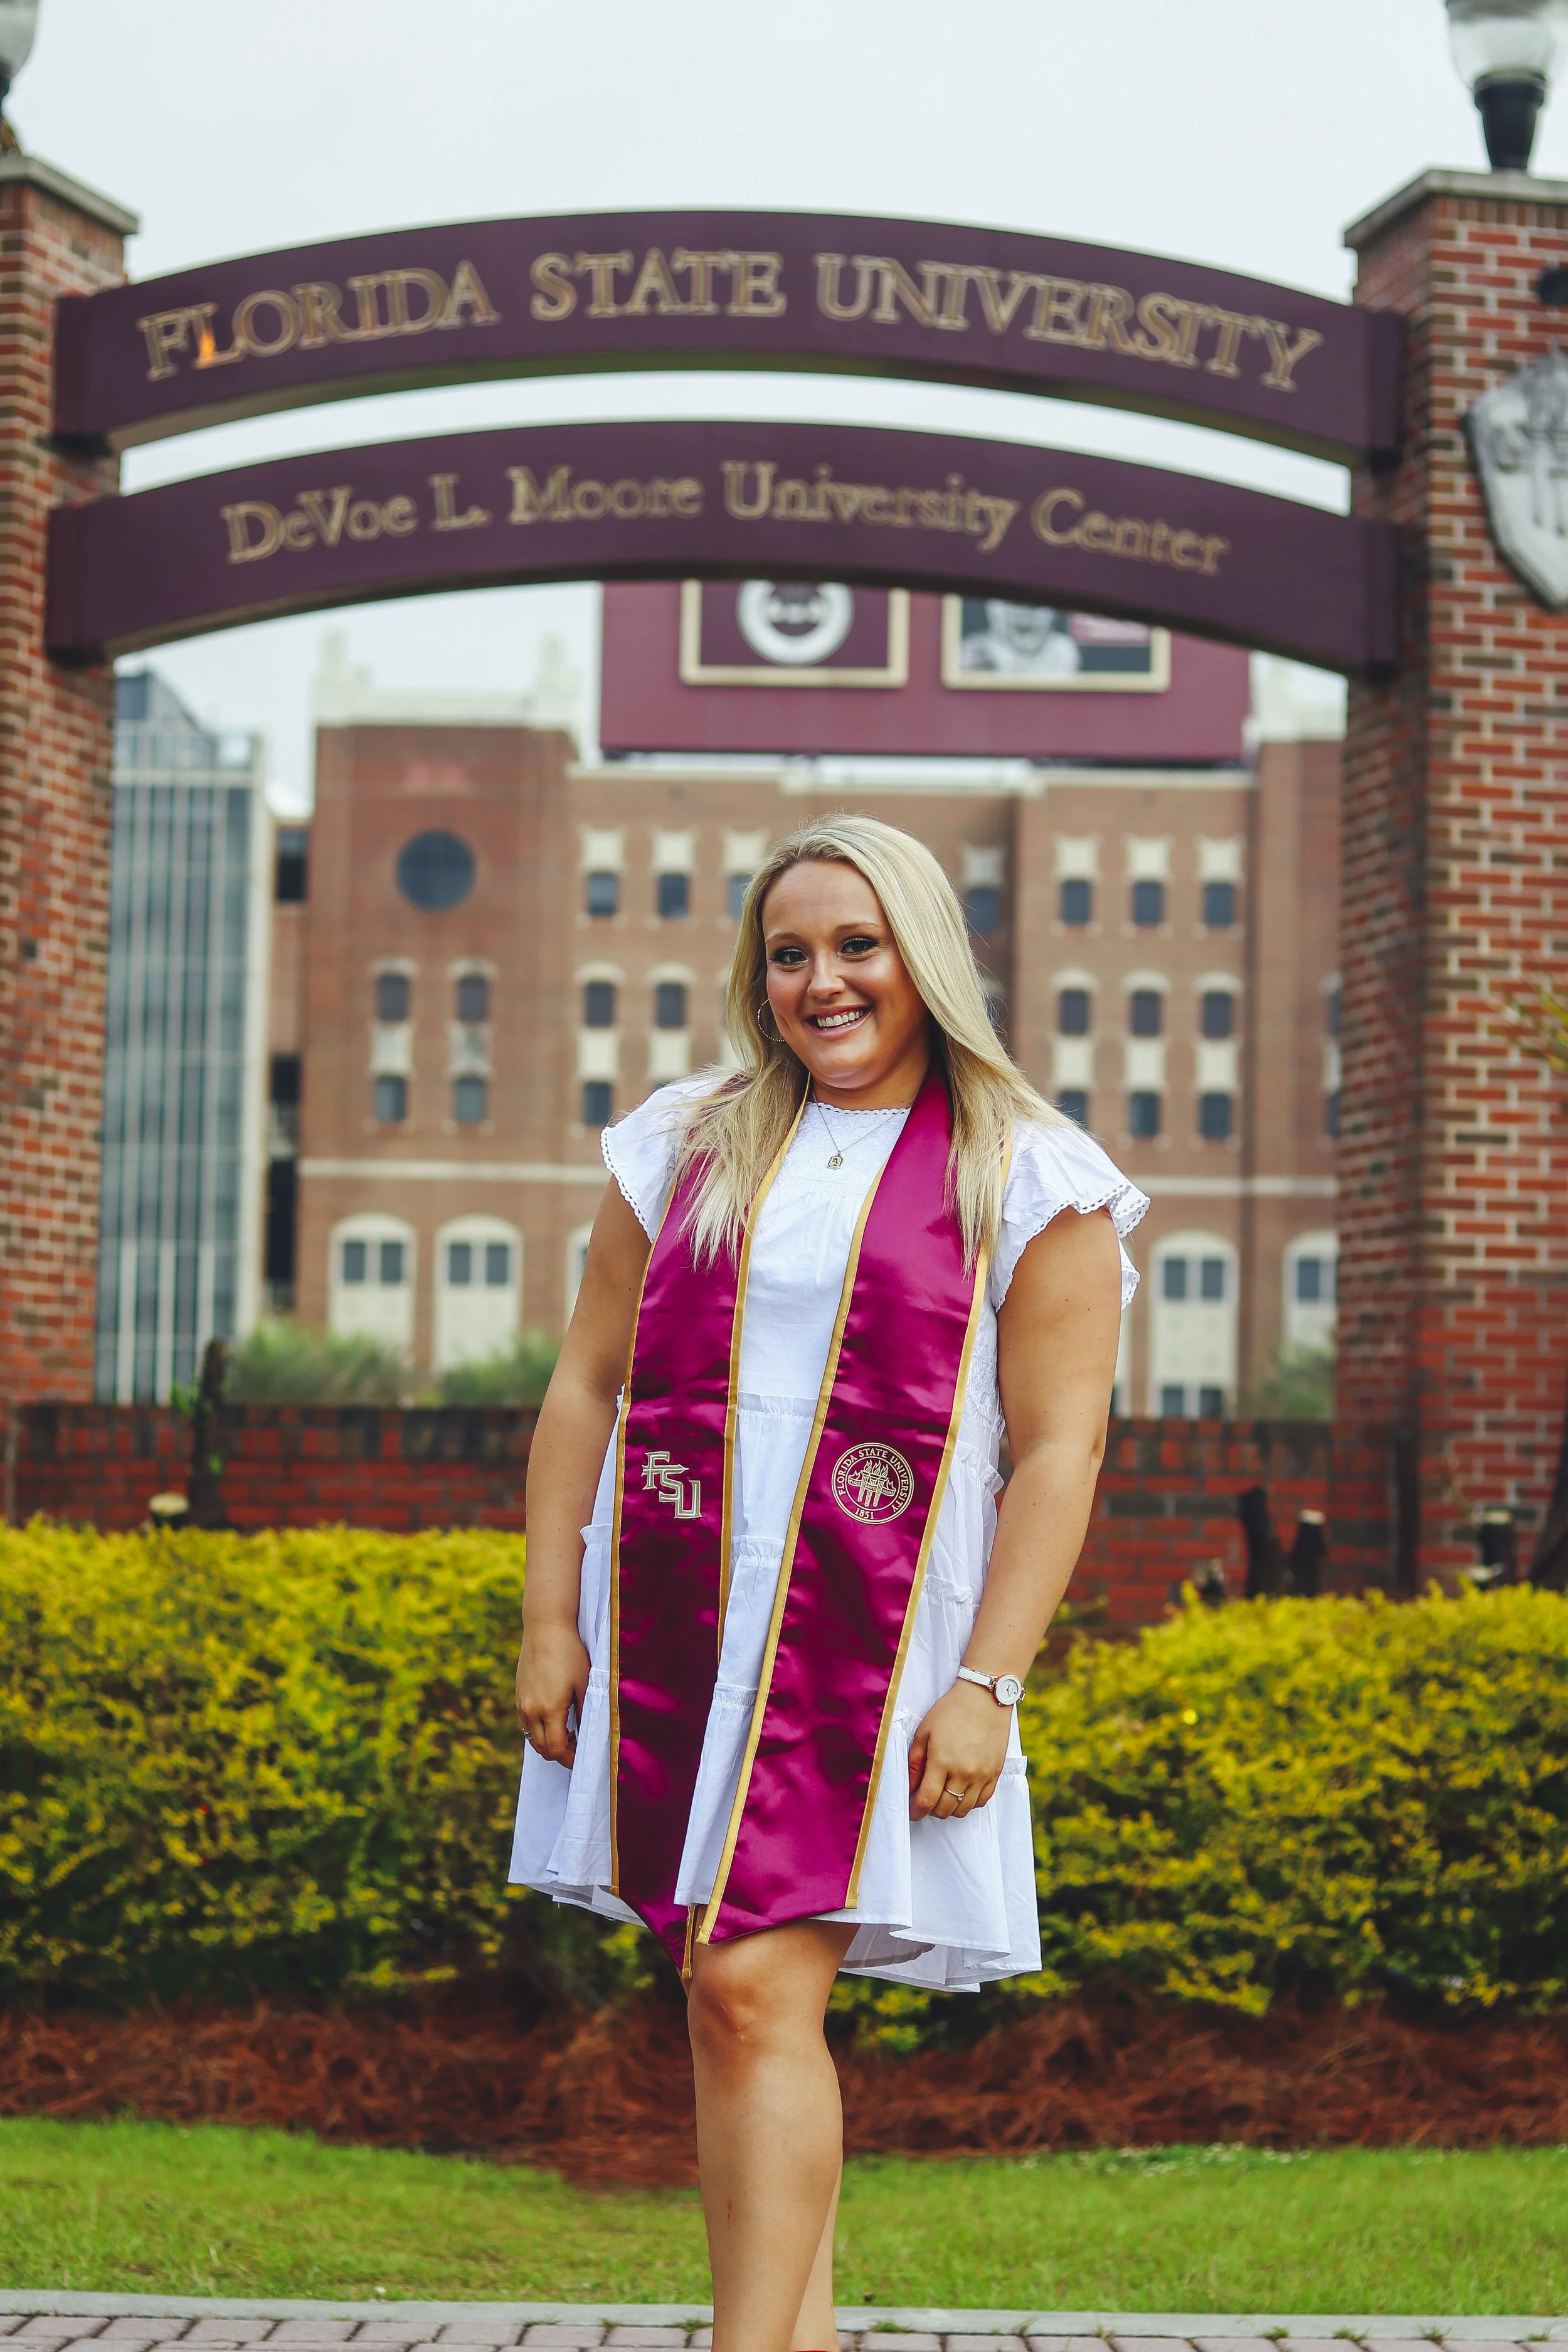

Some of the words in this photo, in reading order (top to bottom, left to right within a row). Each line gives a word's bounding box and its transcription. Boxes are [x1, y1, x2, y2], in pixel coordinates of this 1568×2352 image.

[137, 260, 501, 381] FLORIDA
[531, 247, 787, 321] STATE
[813, 253, 1323, 391] UNIVERSITY
[220, 485, 418, 563] DeVoe
[428, 473, 492, 532] L.
[505, 464, 704, 524] Moore
[719, 460, 1019, 554] University
[1030, 487, 1231, 575] Center
[641, 1451, 702, 1518] FSU
[837, 1454, 857, 1496] FLORIDA
[858, 1448, 889, 1458] STATE
[889, 1455, 909, 1513] UNIVERSITY
[855, 1508, 874, 1520] 1851
